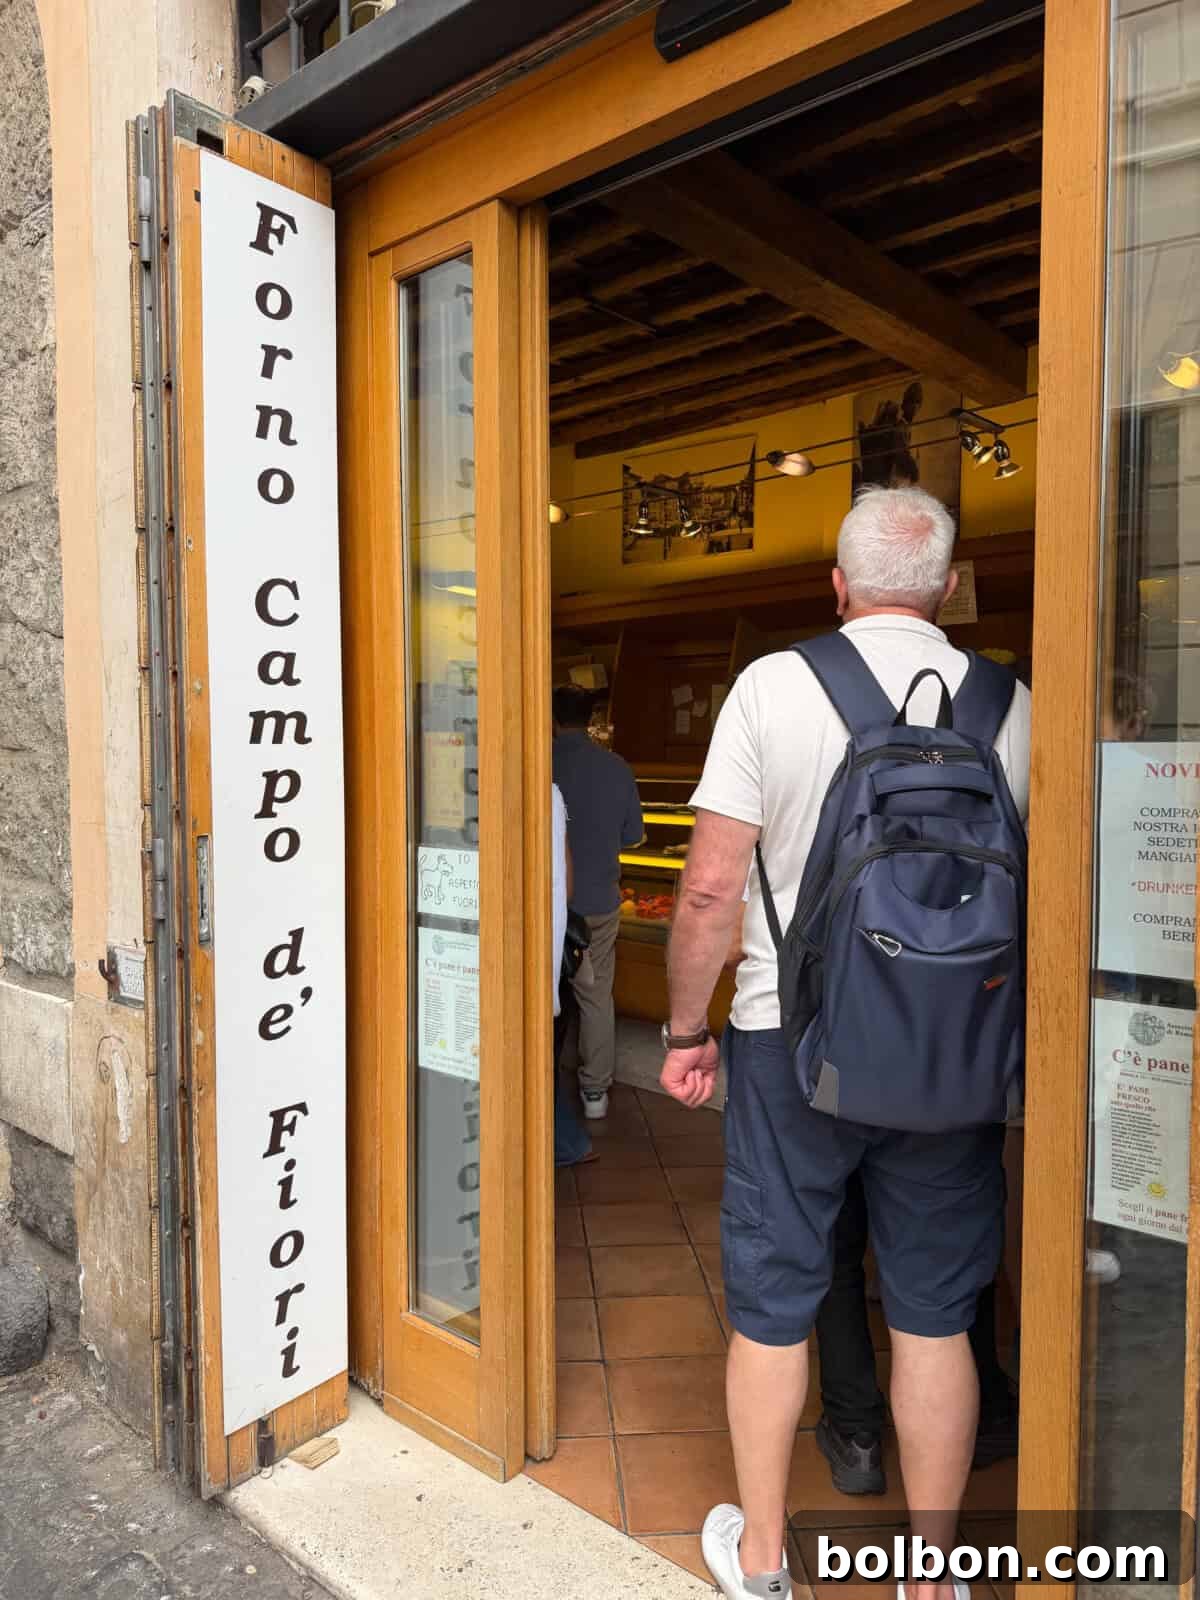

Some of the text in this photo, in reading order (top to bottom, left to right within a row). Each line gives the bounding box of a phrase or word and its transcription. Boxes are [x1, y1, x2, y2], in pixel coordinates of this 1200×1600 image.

[249, 201, 298, 505] Forno
[249, 578, 312, 863] Campo
[1133, 821, 1189, 833] NOSTRA
[1140, 806, 1200, 818] COMPRA
[1147, 1058, 1190, 1073] pane
[262, 1101, 309, 1379] Fiori
